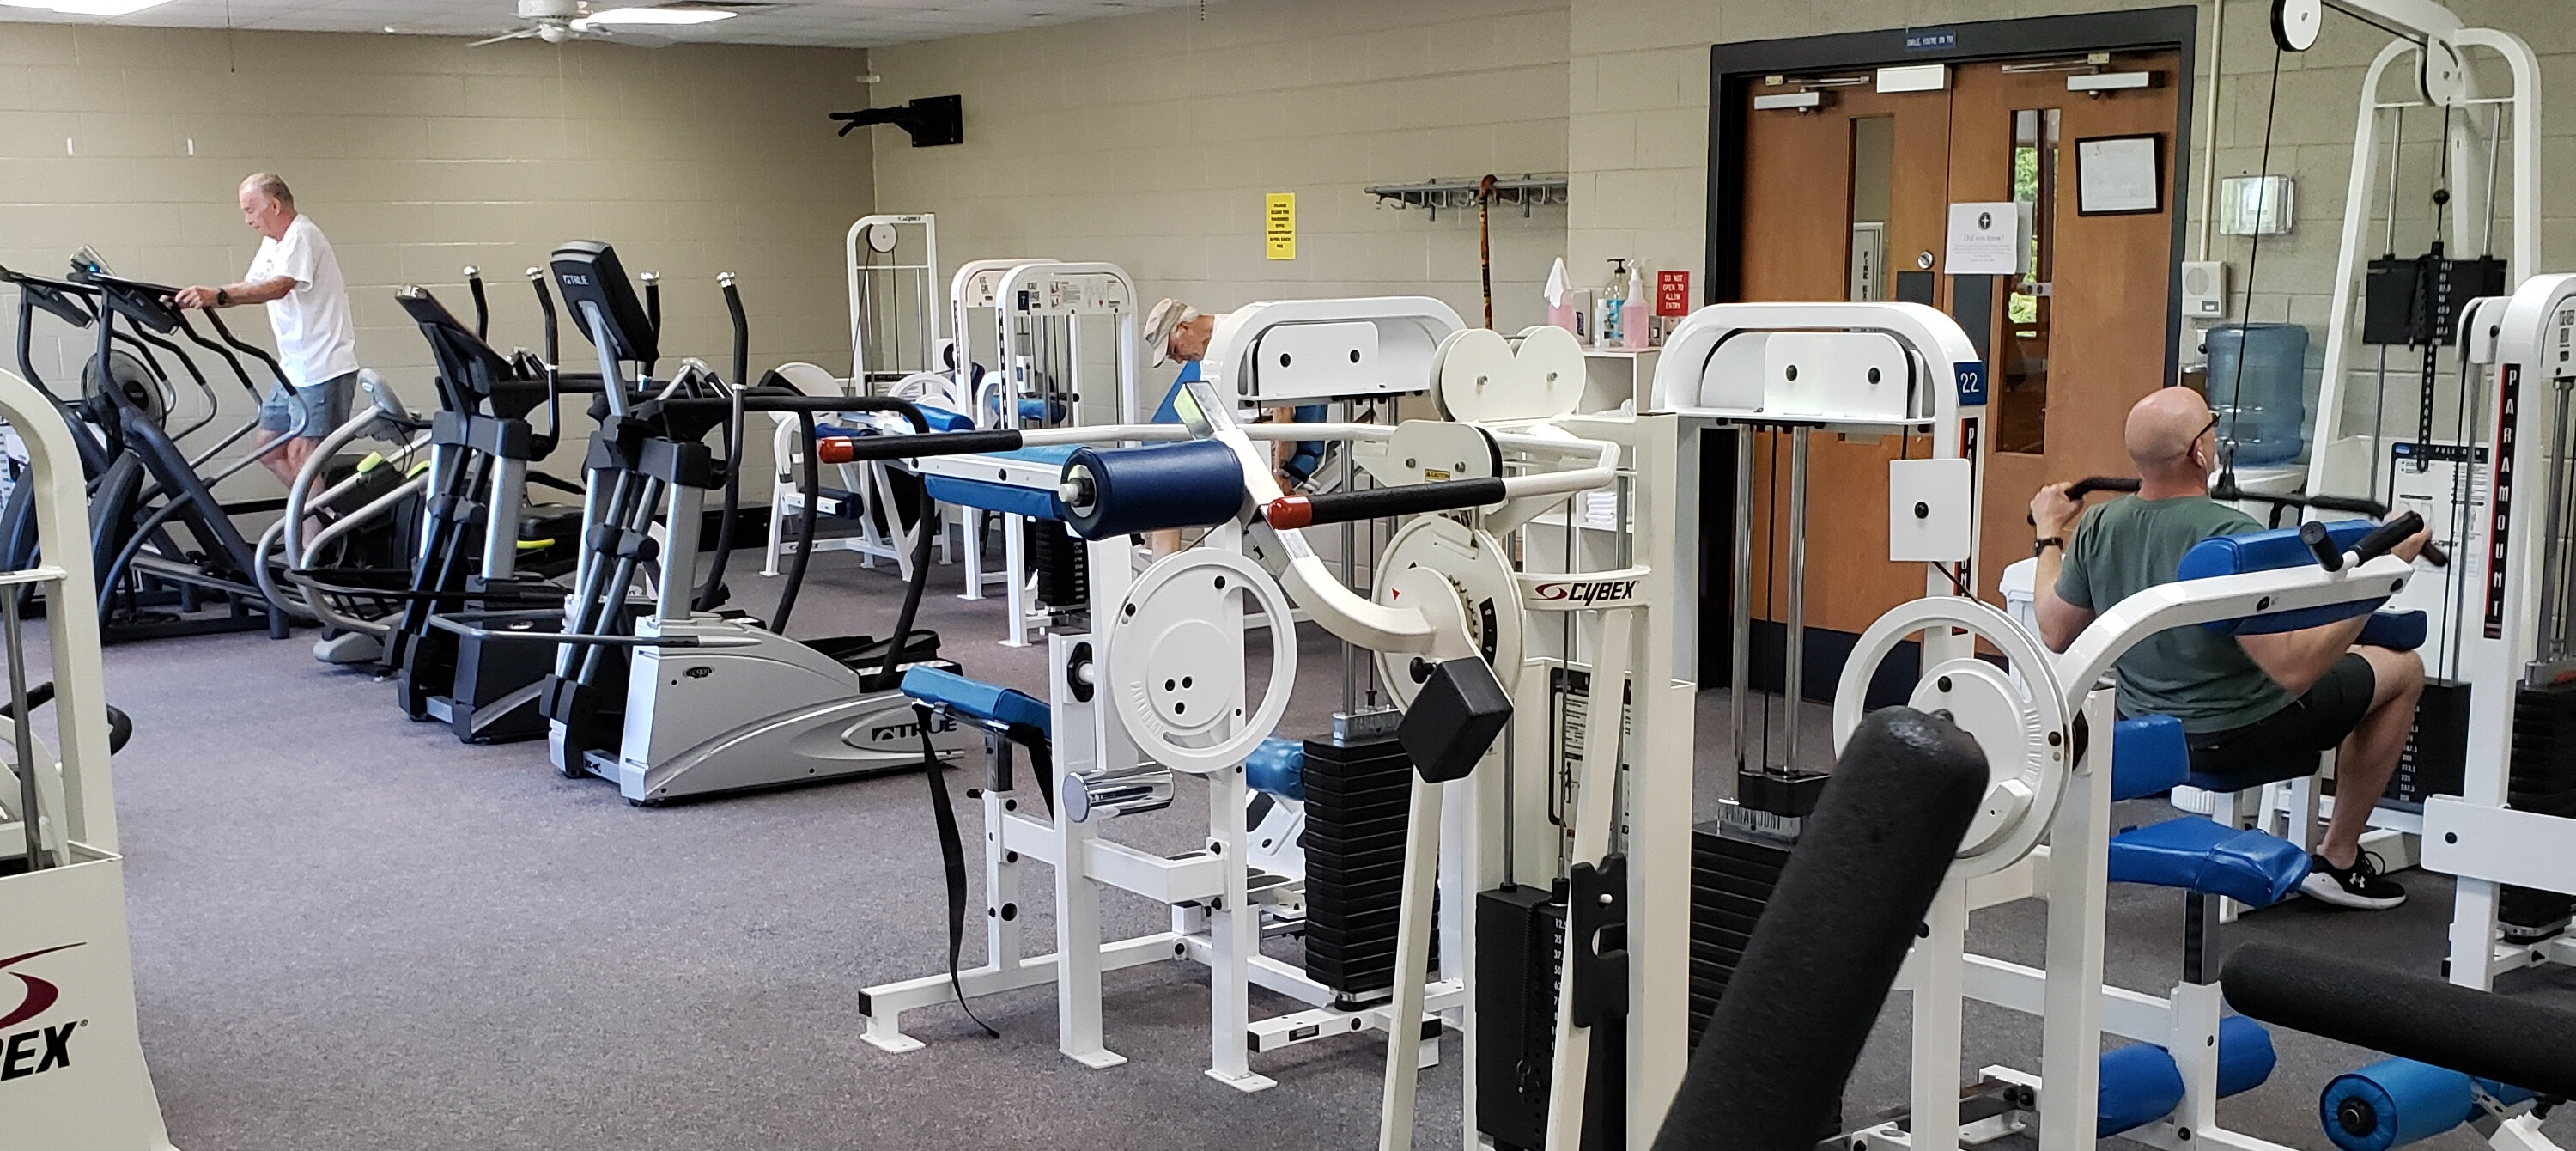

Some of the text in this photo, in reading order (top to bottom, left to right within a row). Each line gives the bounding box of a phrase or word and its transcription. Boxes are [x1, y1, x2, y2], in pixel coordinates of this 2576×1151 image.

[1960, 372, 1979, 393] 22
[2493, 369, 2517, 617] PARAMOUNT
[1568, 581, 1637, 606] CYBEX
[1554, 934, 1562, 944] 25
[0, 1021, 77, 1081] EX
